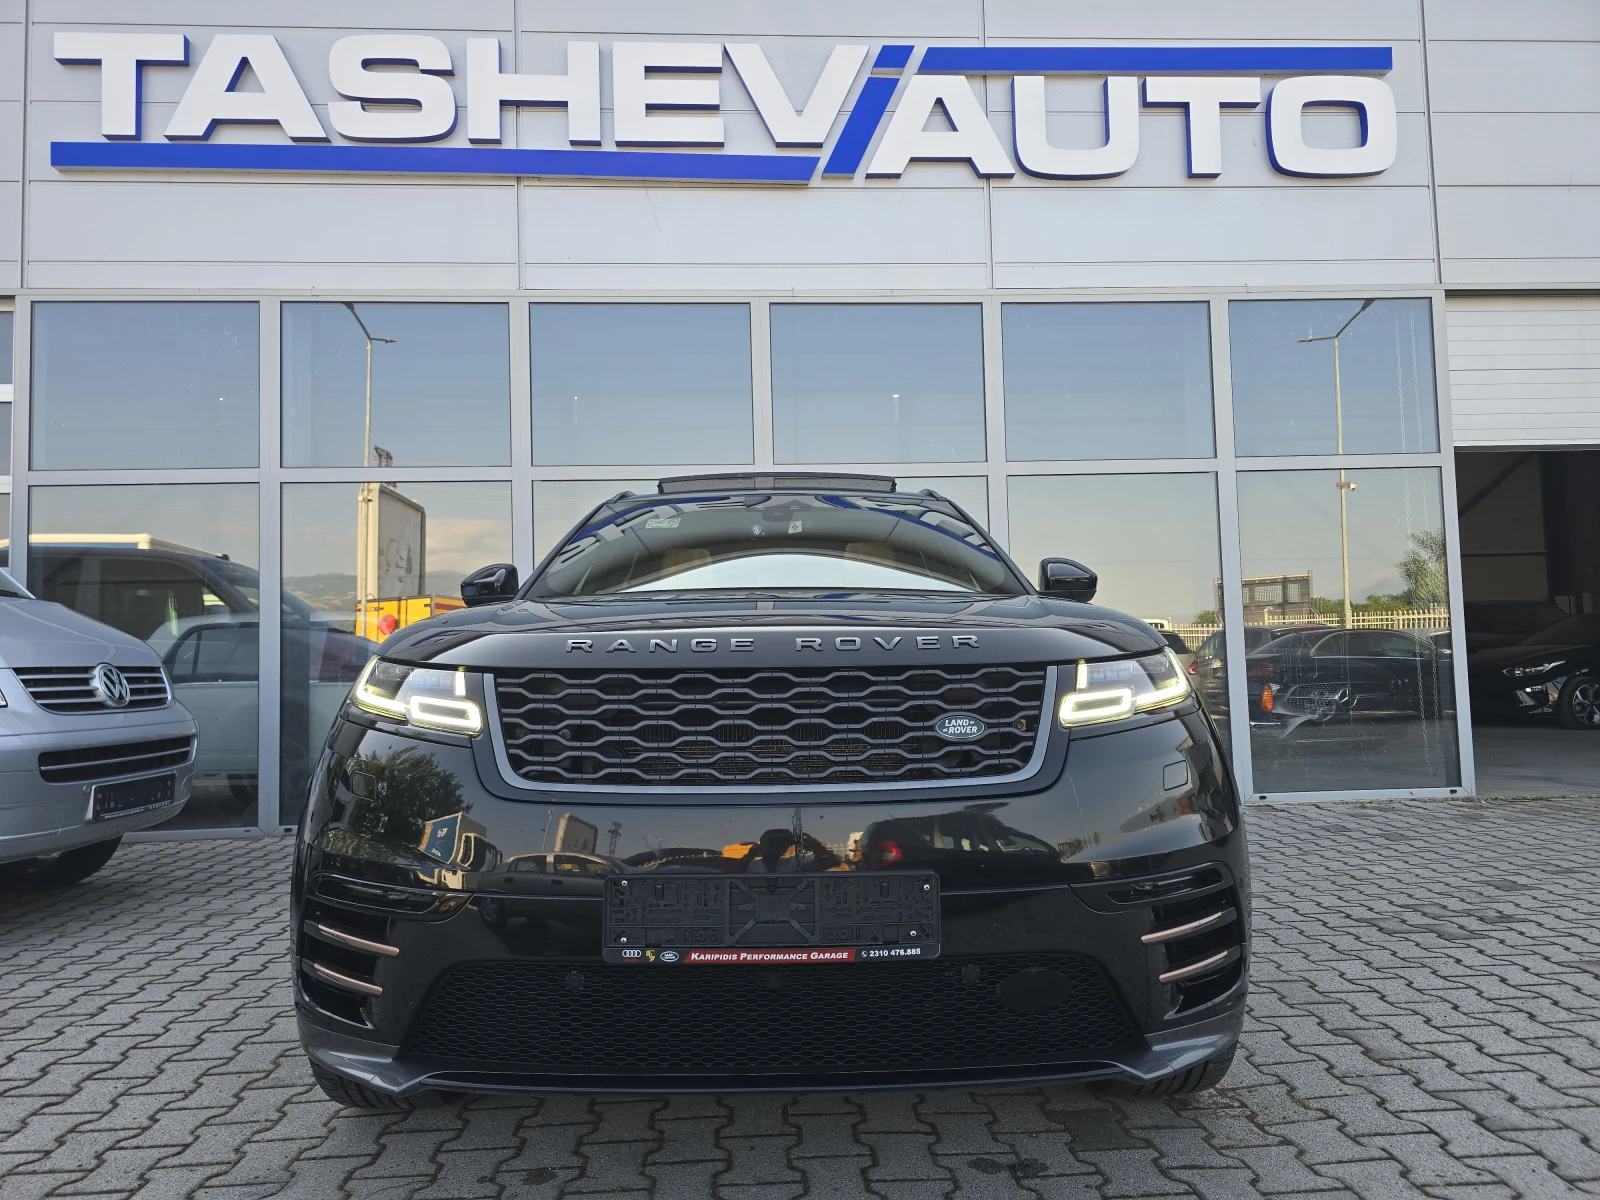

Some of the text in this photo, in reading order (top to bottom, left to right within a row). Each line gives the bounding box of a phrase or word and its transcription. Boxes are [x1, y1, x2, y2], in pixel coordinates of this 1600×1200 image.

[53, 32, 1397, 180] TASHEV AUTO
[566, 635, 980, 653] RANGE ROVER
[948, 726, 977, 734] ROVER
[869, 949, 888, 957] 2310
[890, 948, 921, 956] 476.885
